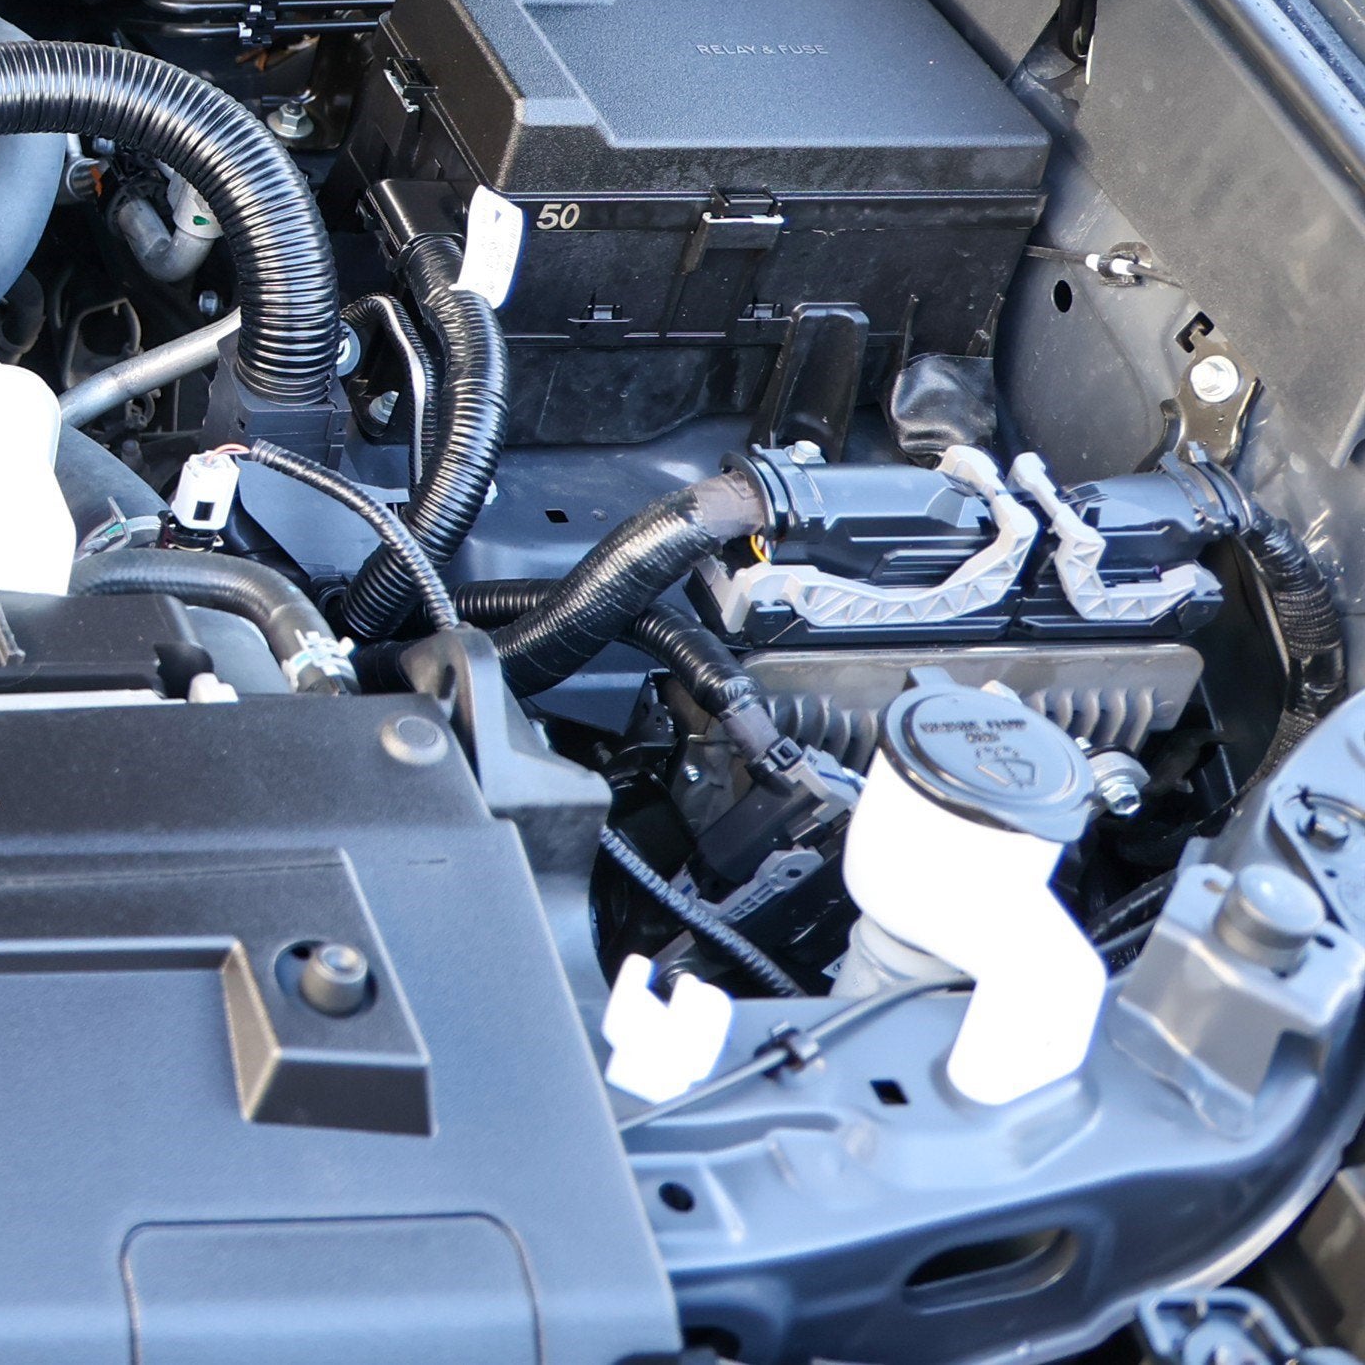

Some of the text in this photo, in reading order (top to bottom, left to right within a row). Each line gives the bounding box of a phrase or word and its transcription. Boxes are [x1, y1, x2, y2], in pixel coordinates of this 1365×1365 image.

[696, 44, 829, 55] RELAY & FUSE
[536, 203, 580, 230] 50
